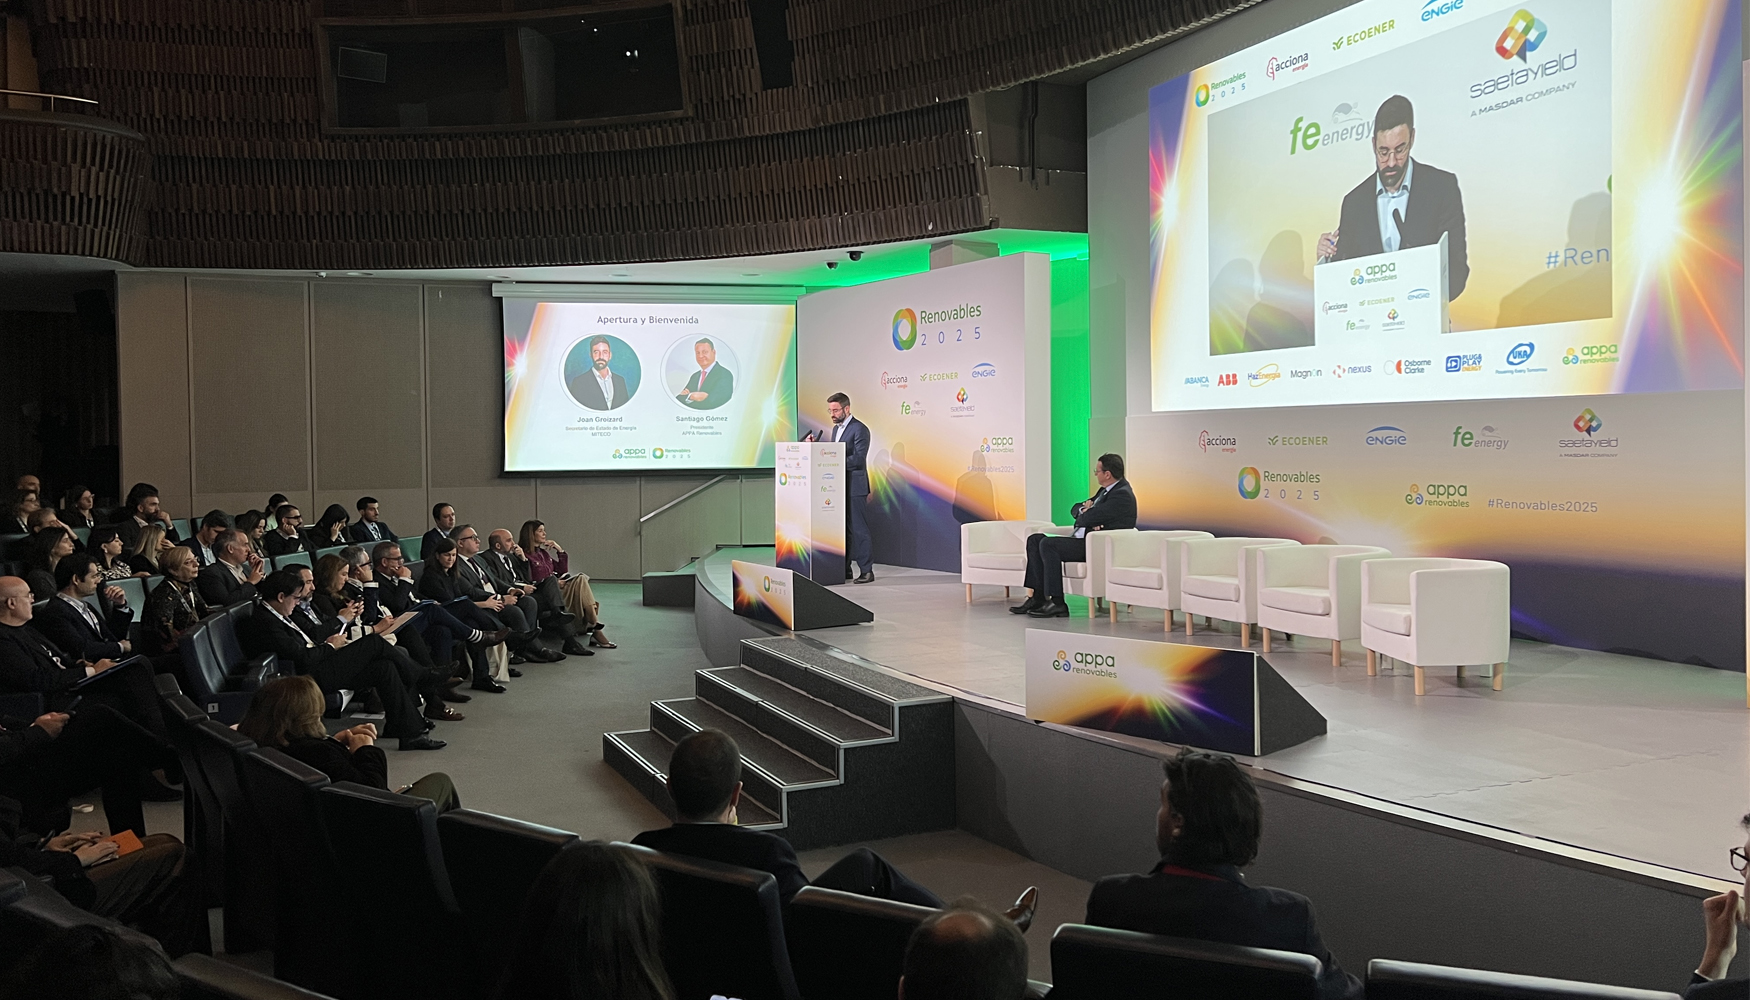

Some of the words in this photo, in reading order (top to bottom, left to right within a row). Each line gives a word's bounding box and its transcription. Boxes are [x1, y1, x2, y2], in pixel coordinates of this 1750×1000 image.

[1346, 19, 1395, 46] ECOENER
[1275, 53, 1309, 72] acciona
[1470, 49, 1577, 99] saetayield
[1211, 72, 1246, 90] Renovables
[1479, 97, 1524, 115] MASDAR
[1525, 81, 1577, 102] COMPANY
[1290, 116, 1321, 155] fe
[1322, 120, 1374, 146] energy
[1366, 262, 1396, 277] appa
[1365, 274, 1397, 284] renovables
[1328, 303, 1348, 311] acciona
[597, 316, 638, 325] Apertura
[648, 316, 699, 324] Bienvenida
[920, 303, 982, 325] Renovables
[1512, 350, 1528, 359] UKA
[1581, 344, 1618, 357] appa
[1347, 365, 1372, 374] nexus
[1404, 359, 1431, 367] Osborne
[886, 375, 908, 384] acciona
[928, 372, 959, 382] ECOENER
[1217, 373, 1238, 386] ABB
[901, 401, 911, 415] fe
[991, 437, 1013, 447] appa
[1206, 435, 1236, 446] acciona
[1281, 436, 1328, 446] ECOENER
[1452, 426, 1474, 447] fe
[1474, 438, 1509, 450] energy
[1559, 437, 1618, 448] saetayield
[1263, 470, 1321, 483] Renovables
[1426, 484, 1468, 499] appa
[1425, 499, 1470, 508] renovables
[1488, 498, 1598, 513] #Renovables2025
[1074, 652, 1115, 668] appa
[1072, 667, 1117, 678] renovables
